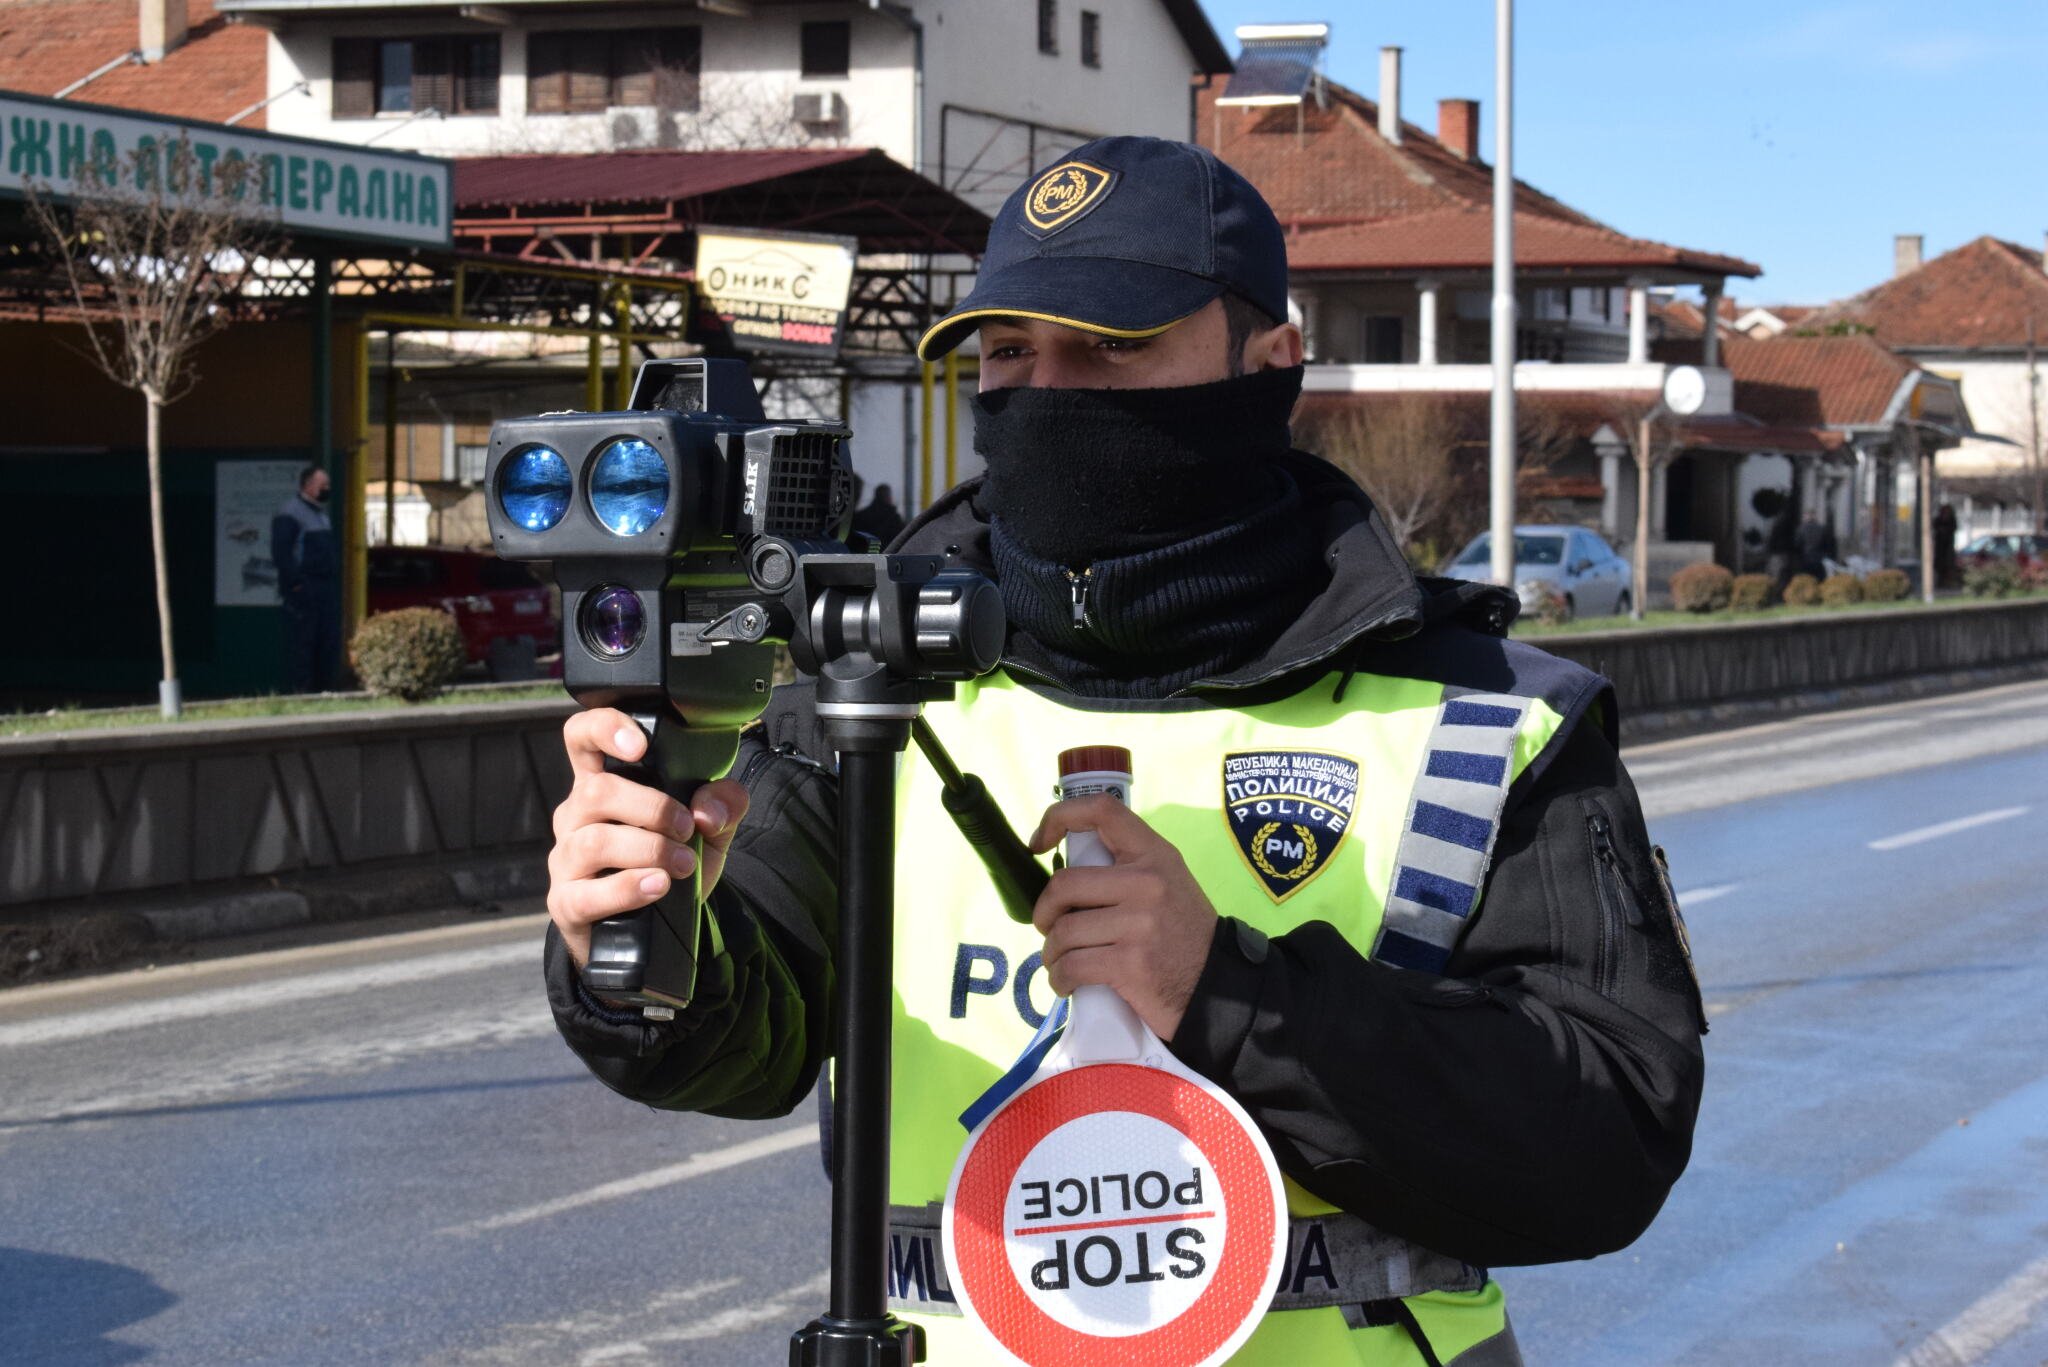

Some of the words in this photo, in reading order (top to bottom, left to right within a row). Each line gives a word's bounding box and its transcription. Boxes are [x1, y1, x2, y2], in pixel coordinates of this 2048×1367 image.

[0, 115, 117, 186] ЖНА
[743, 459, 759, 515] SLIK
[1226, 756, 1288, 773] РЕПУБЛИКА
[1292, 756, 1358, 783] МАКЕДОНИЈА
[1226, 777, 1355, 813] ПОЛИЦИЈА
[1235, 800, 1345, 833] POLICE
[1021, 1167, 1204, 1220] POLICE
[1031, 1227, 1206, 1291] STOP
